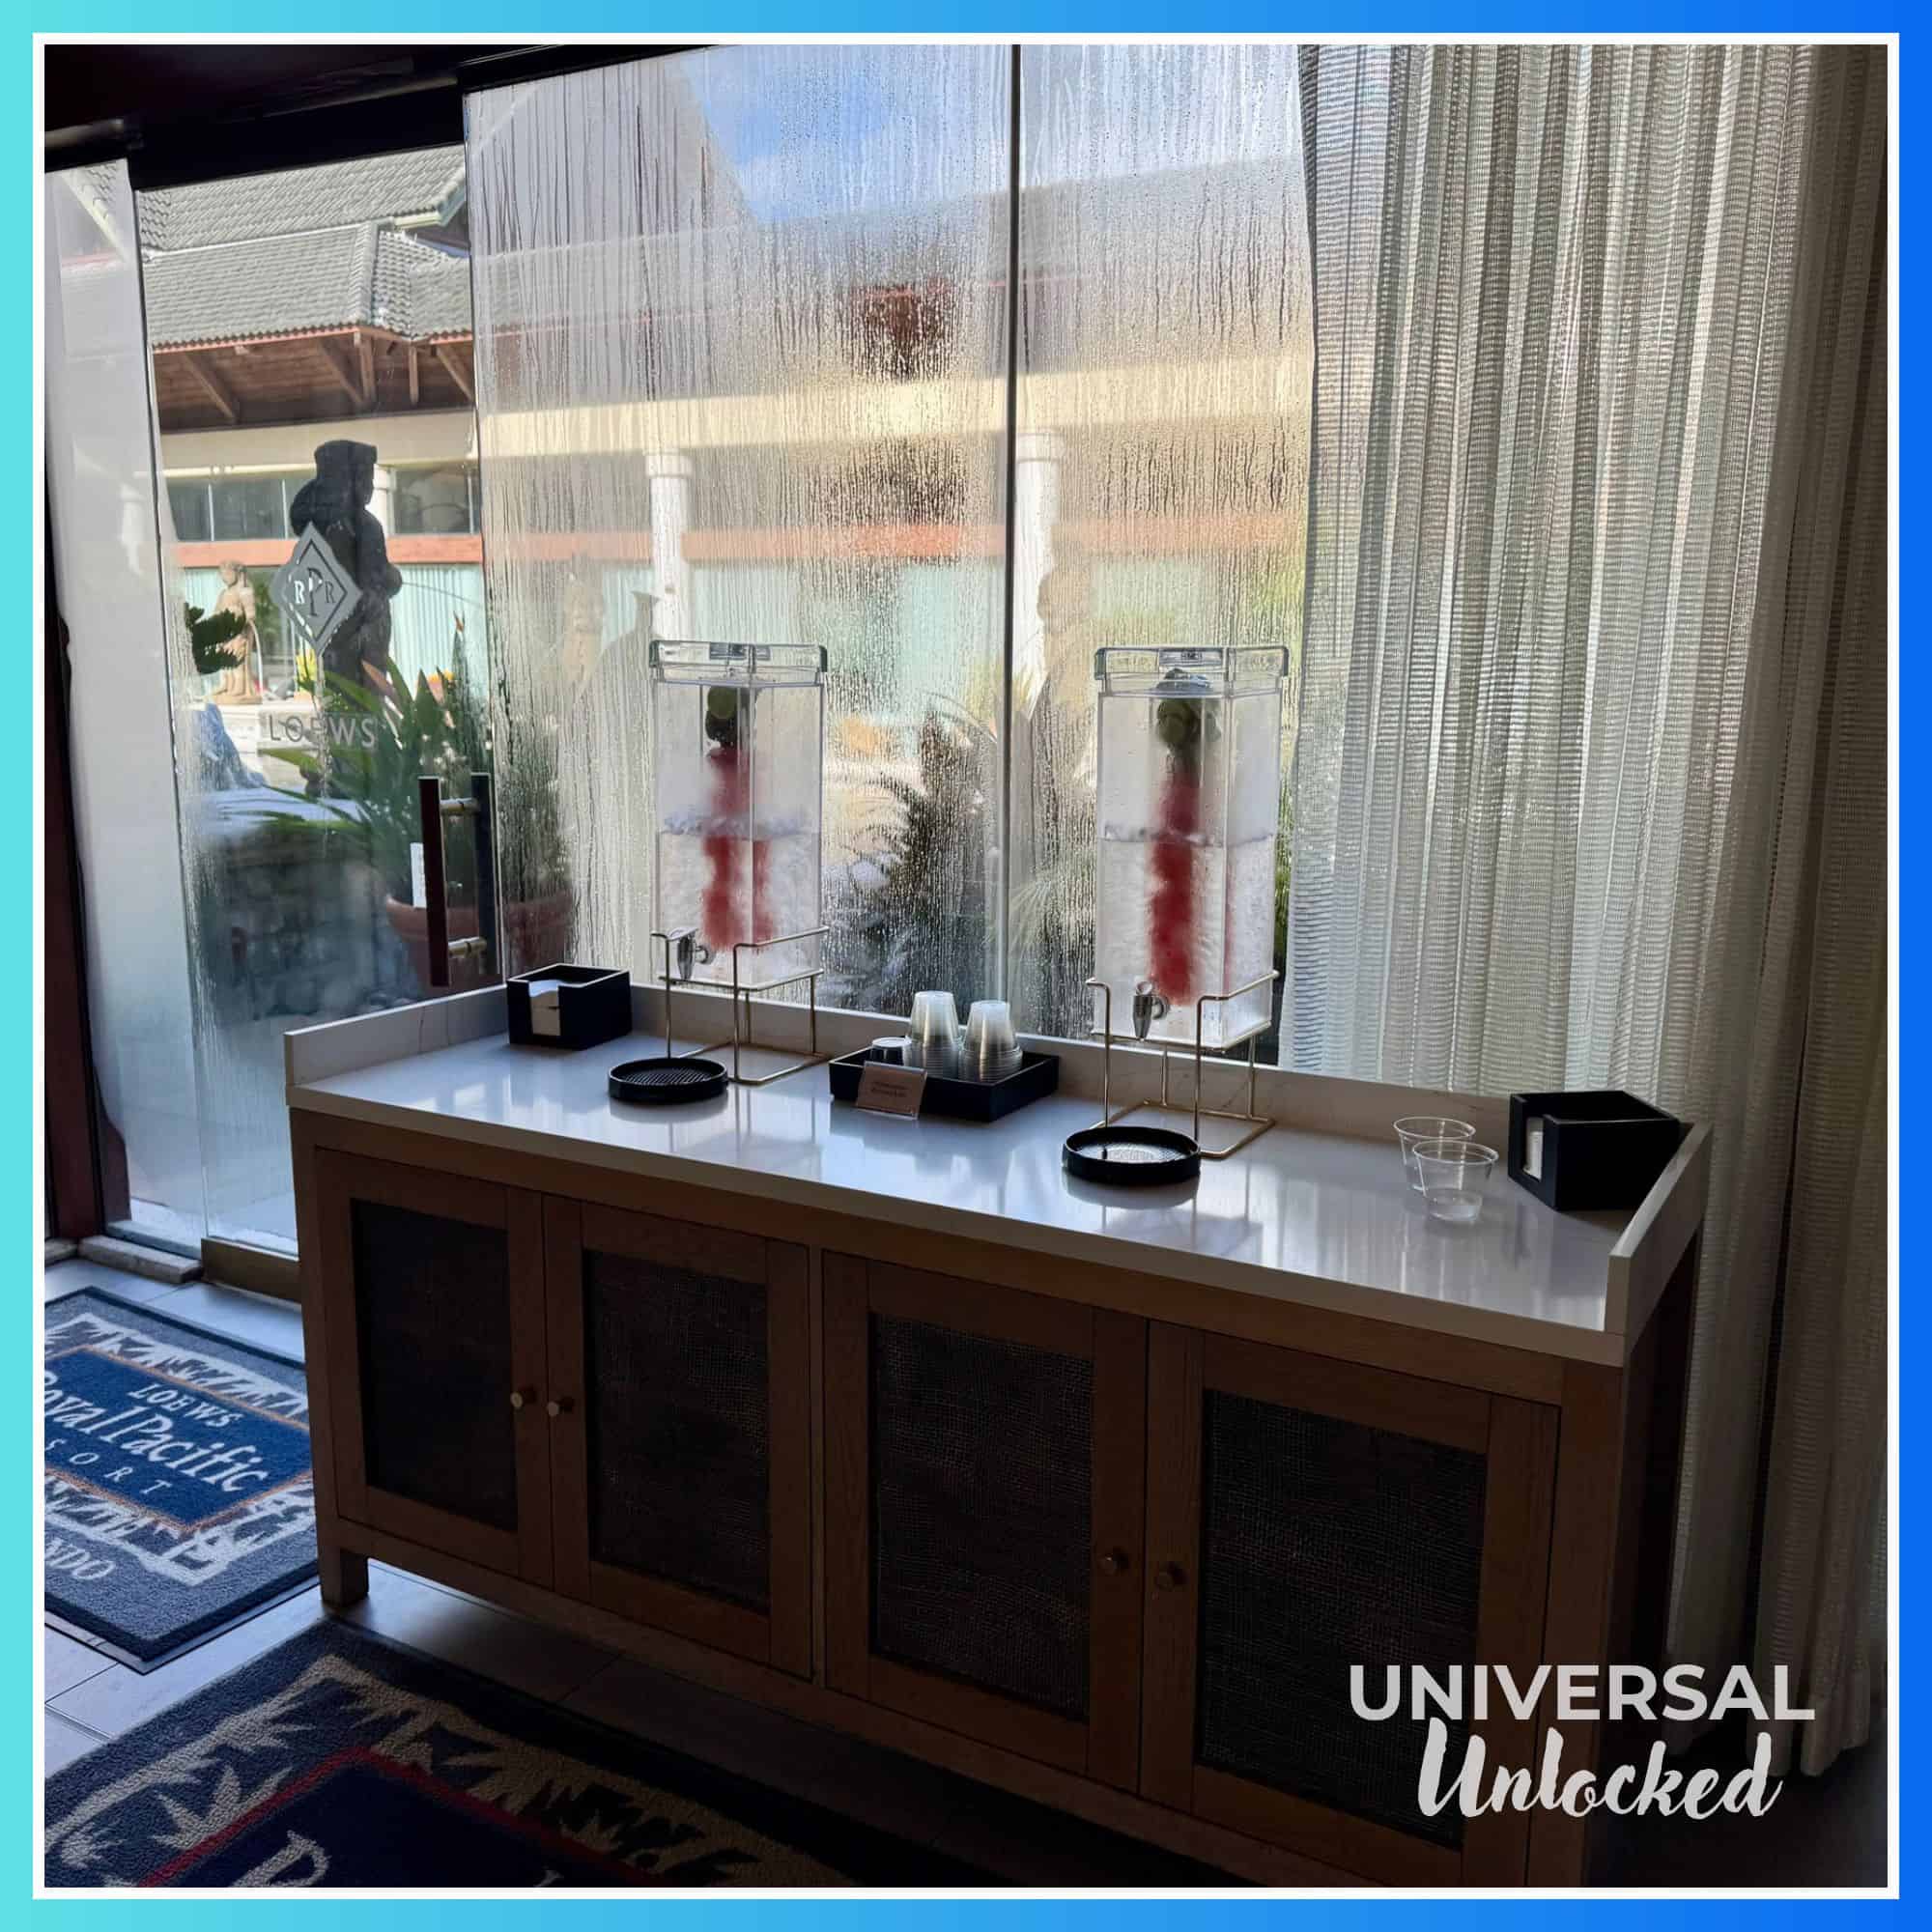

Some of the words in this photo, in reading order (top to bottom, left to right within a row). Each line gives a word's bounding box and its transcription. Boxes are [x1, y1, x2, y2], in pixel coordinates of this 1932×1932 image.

[269, 714, 376, 749] LOEWS
[128, 1382, 242, 1428] LOEWS
[99, 1413, 269, 1492] Pacific
